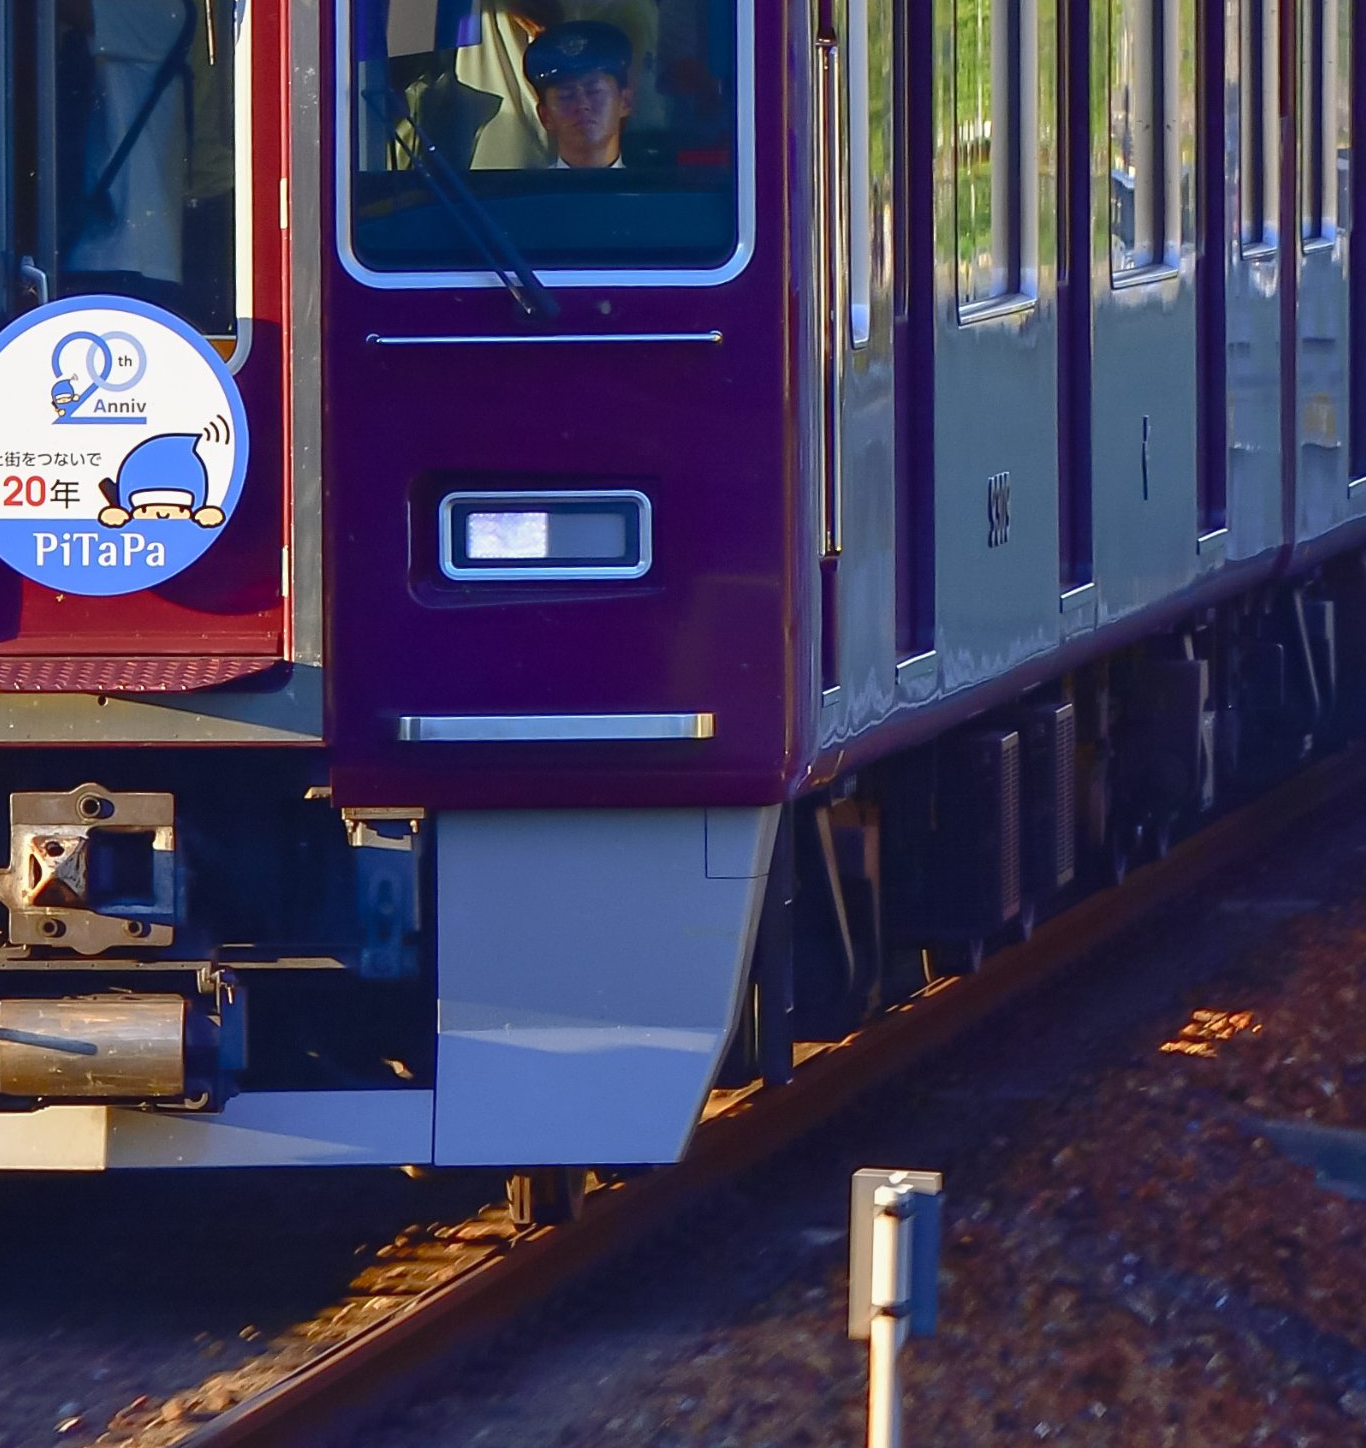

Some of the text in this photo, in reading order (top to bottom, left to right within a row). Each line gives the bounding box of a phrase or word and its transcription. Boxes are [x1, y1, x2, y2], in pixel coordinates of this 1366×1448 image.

[93, 398, 146, 413] Anniv
[3, 475, 81, 509] 20年
[33, 532, 166, 567] PiTaPa
